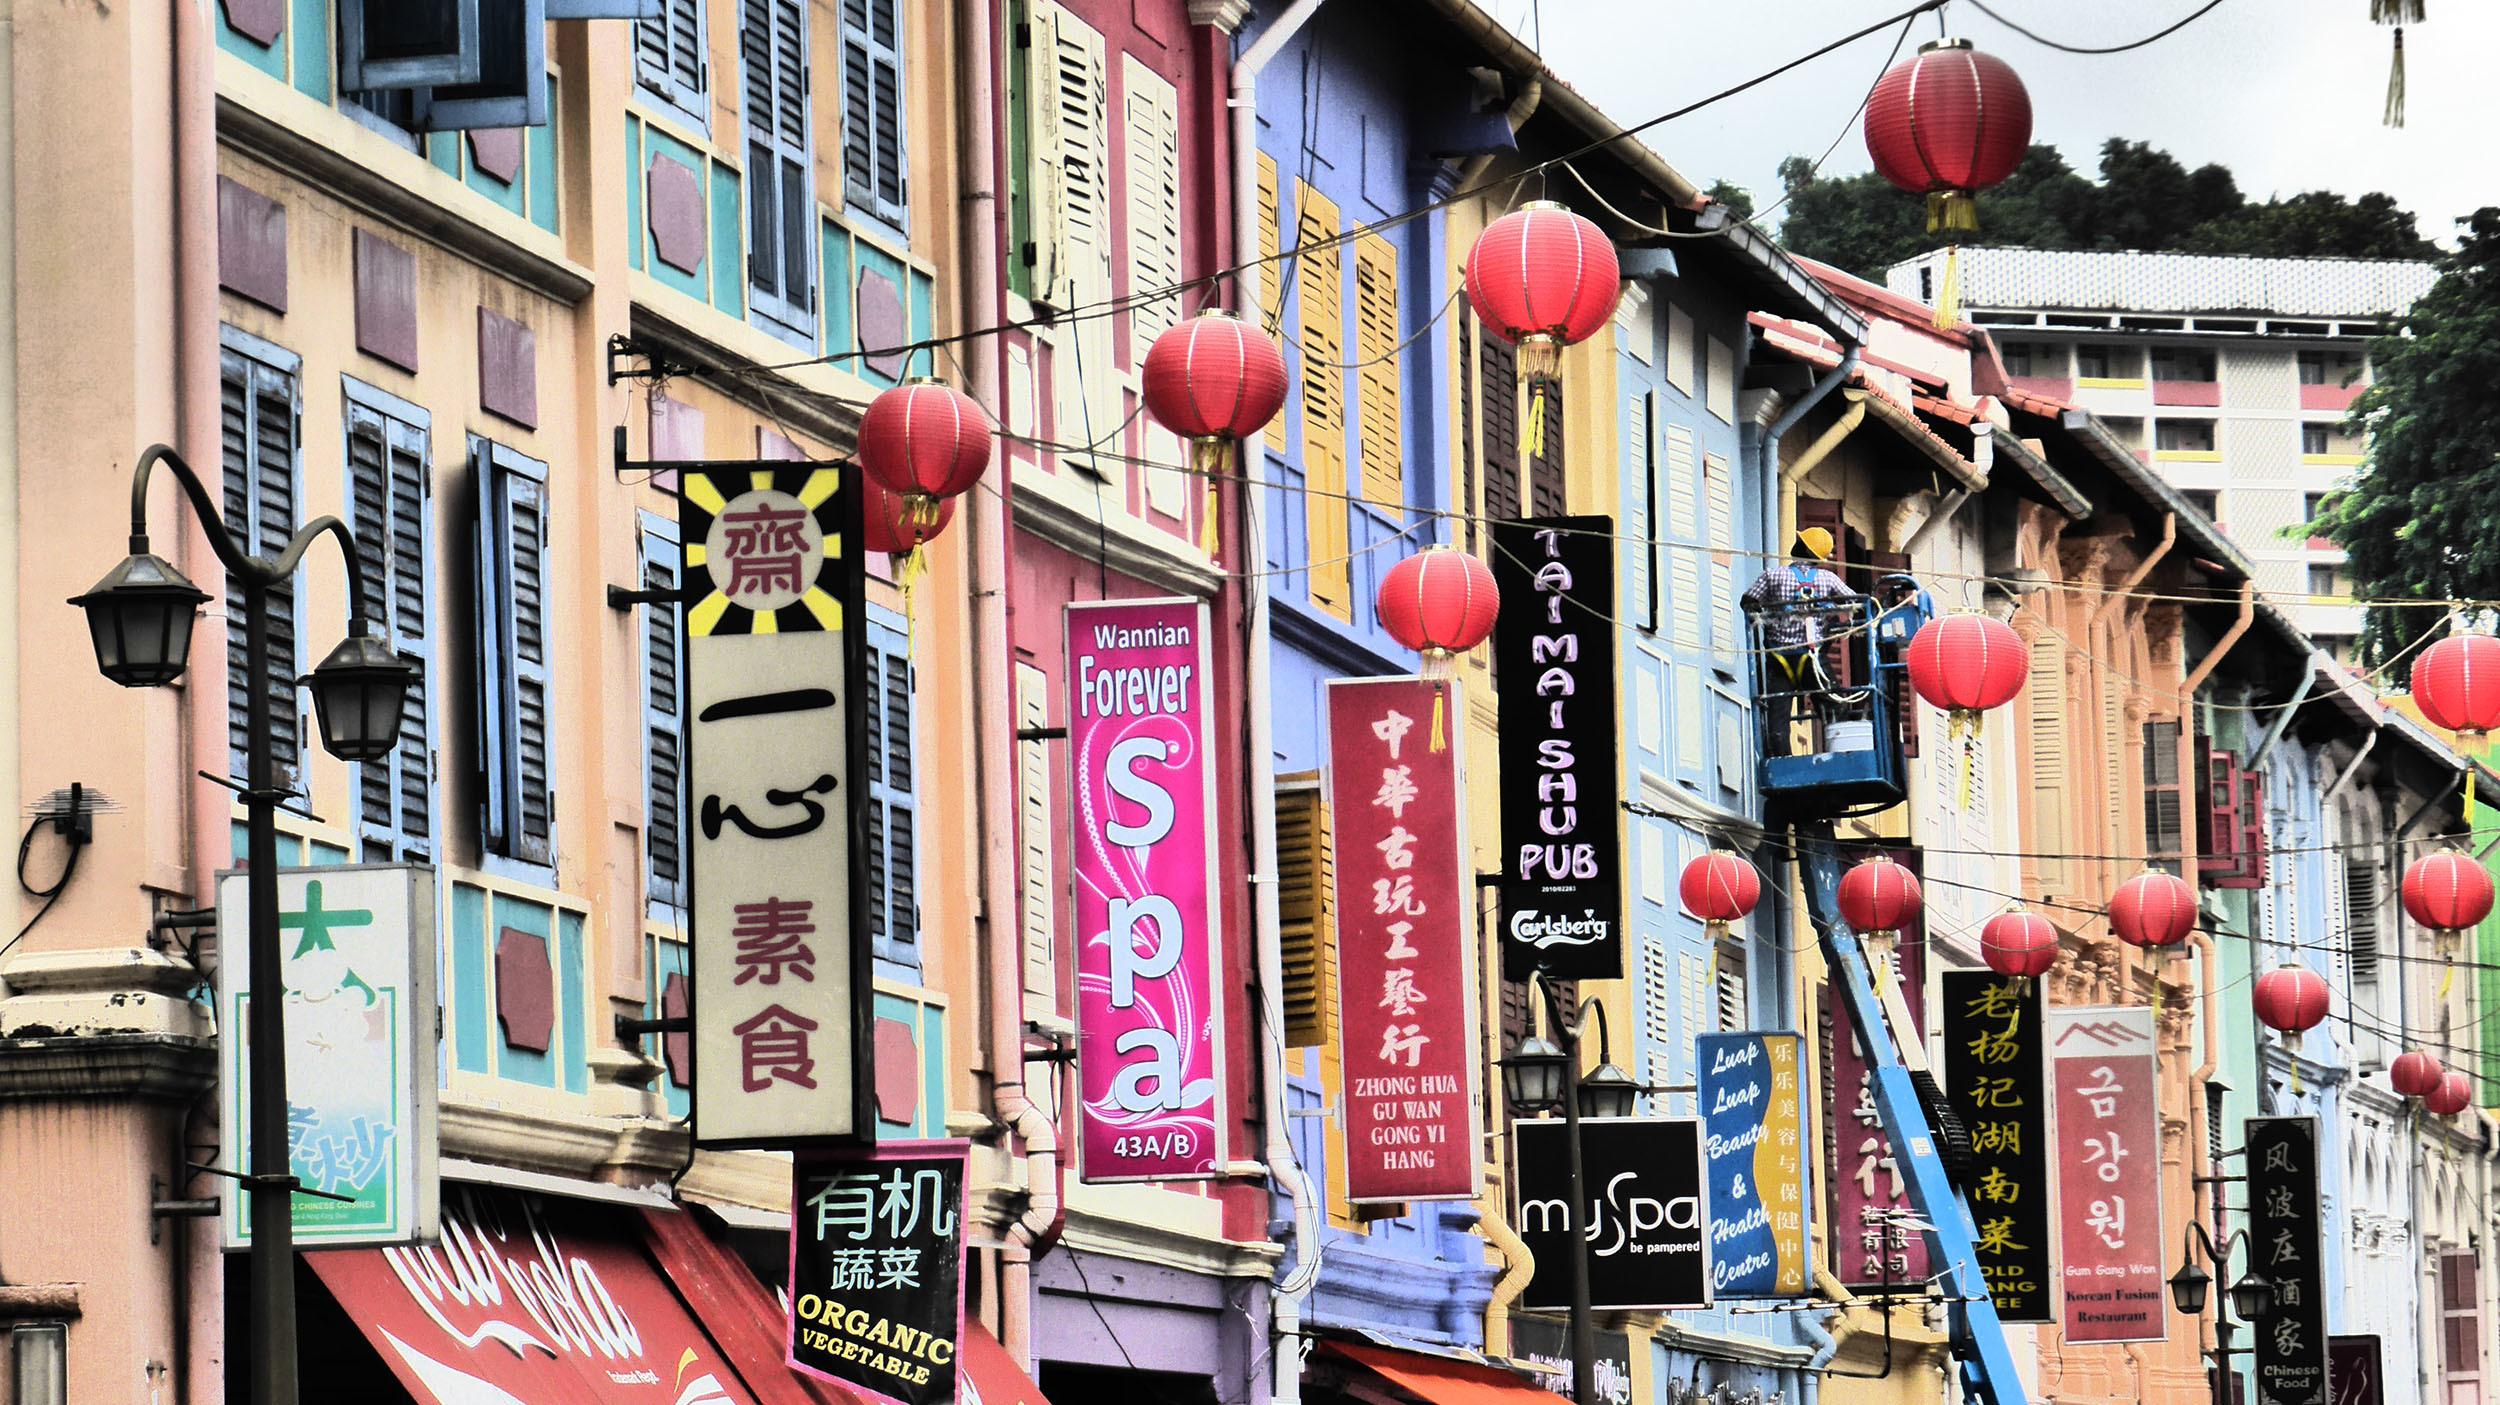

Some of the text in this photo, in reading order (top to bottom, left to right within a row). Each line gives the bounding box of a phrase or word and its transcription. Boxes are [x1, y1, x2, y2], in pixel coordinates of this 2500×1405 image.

[1094, 621, 1190, 649] Wannian
[1080, 655, 1192, 717] Forever
[1519, 843, 1599, 881] PUB
[1371, 709, 1431, 1067] 中華古玩工藝行
[1104, 736, 1185, 1113] Spa
[1511, 909, 1607, 949] Carlsberg
[732, 897, 818, 1093] 素食
[1711, 1041, 1759, 1075] Luap
[1355, 1074, 1458, 1097] ZHONG HUA
[1712, 1080, 1761, 1115] Luap
[1373, 1100, 1441, 1121] GU WAN
[1112, 1132, 1191, 1160] 43A/B
[1371, 1125, 1420, 1146] GONG
[1706, 1123, 1770, 1160] Beauty
[1383, 1149, 1435, 1170] HANG
[1775, 1043, 1801, 1287] 乐乐美容与保健中心
[2076, 1066, 2129, 1250] 금강원
[806, 1167, 954, 1241] 有机
[1732, 1173, 1747, 1199] &
[1710, 1201, 1772, 1245] Health
[1629, 1241, 1700, 1256] be pampered
[831, 1246, 922, 1290] 蔬菜
[1713, 1250, 1771, 1290] Centre
[2066, 1265, 2092, 1276] Gum
[2095, 1264, 2125, 1277] Gang
[2066, 1288, 2159, 1302] Korean Fusion
[797, 1293, 954, 1365] ORGANIC
[2078, 1311, 2148, 1323] Restaurant
[802, 1328, 930, 1385] VEGETABLE
[2264, 1364, 2321, 1377] Chinese
[2275, 1376, 2310, 1389] Food
